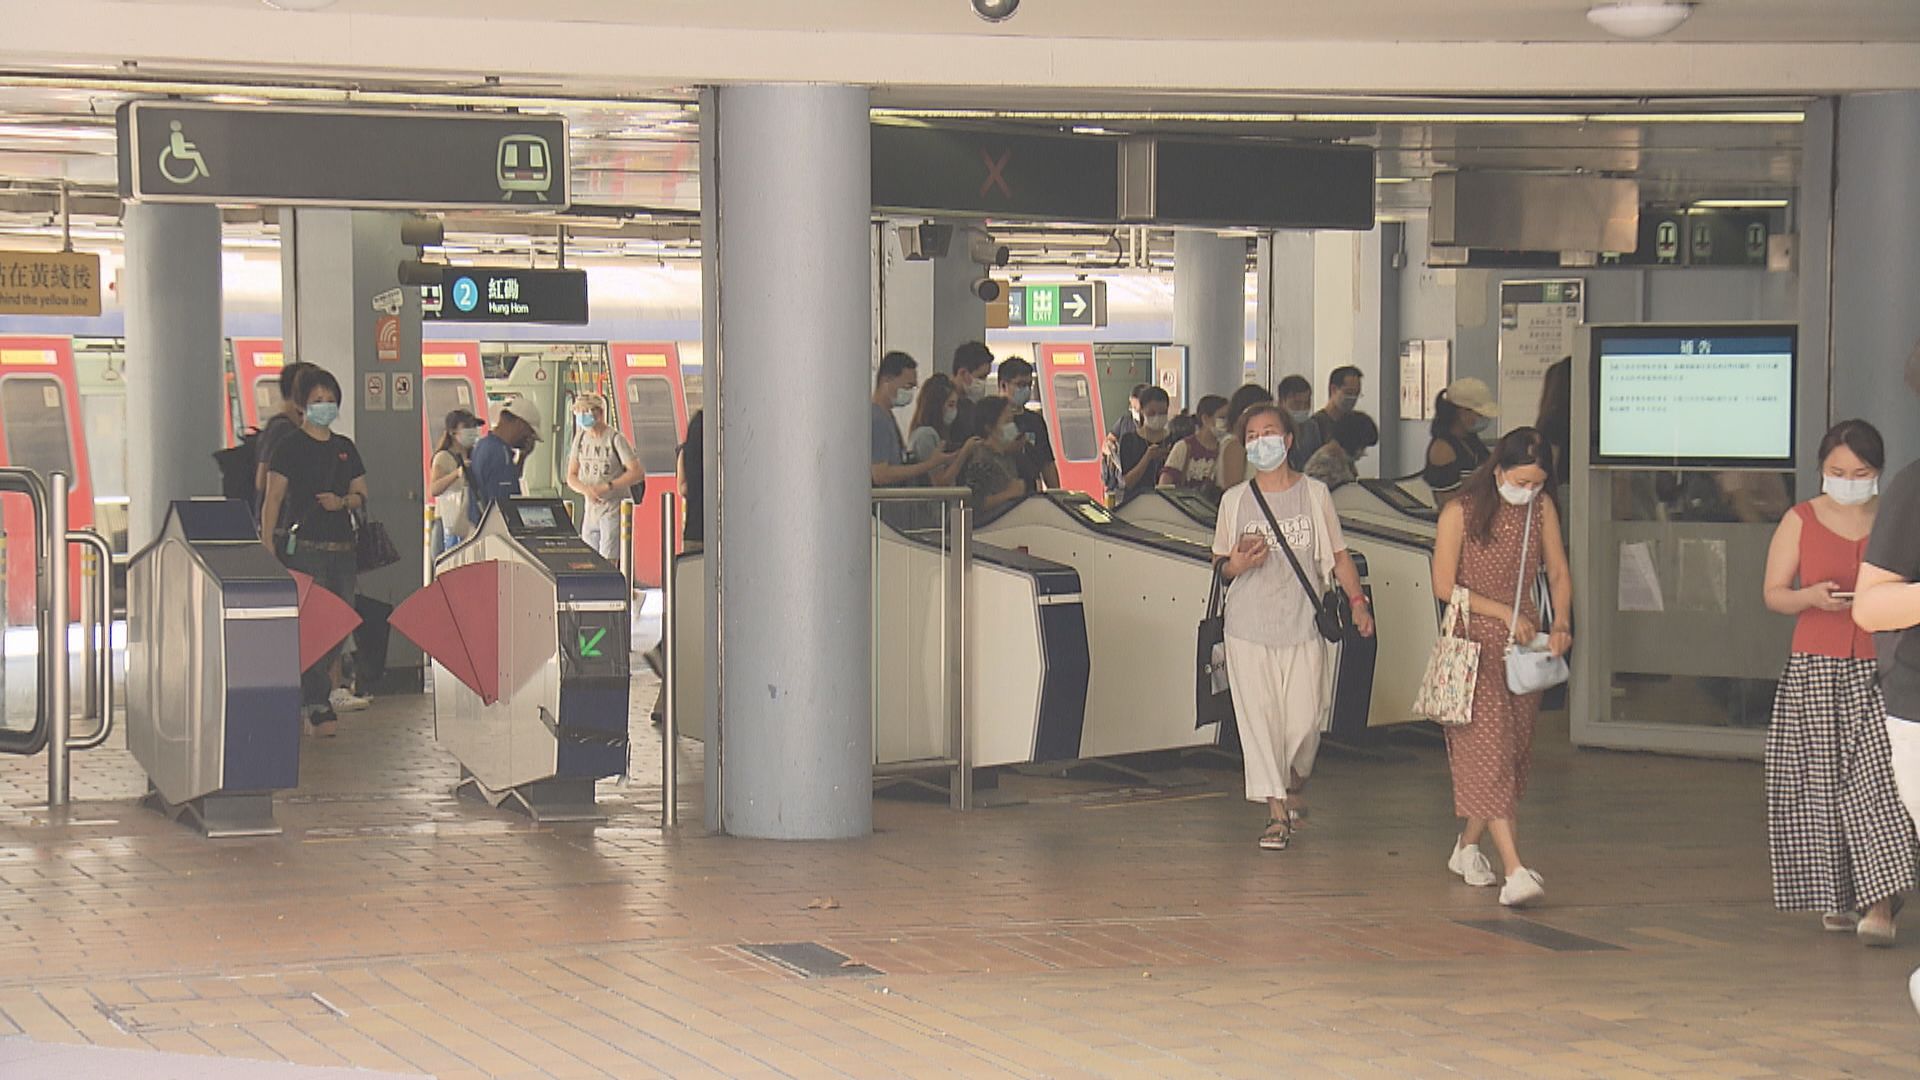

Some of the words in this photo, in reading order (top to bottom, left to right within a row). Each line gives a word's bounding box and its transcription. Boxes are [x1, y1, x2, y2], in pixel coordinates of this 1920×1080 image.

[460, 283, 471, 306] 2
[488, 278, 519, 301] 紅磡
[22, 293, 38, 305] the
[40, 293, 69, 308] yellow
[72, 294, 88, 306] line
[488, 302, 510, 315] Hung
[511, 302, 529, 314] Hom
[1032, 289, 1053, 311] 出
[1032, 311, 1052, 321] EXIT
